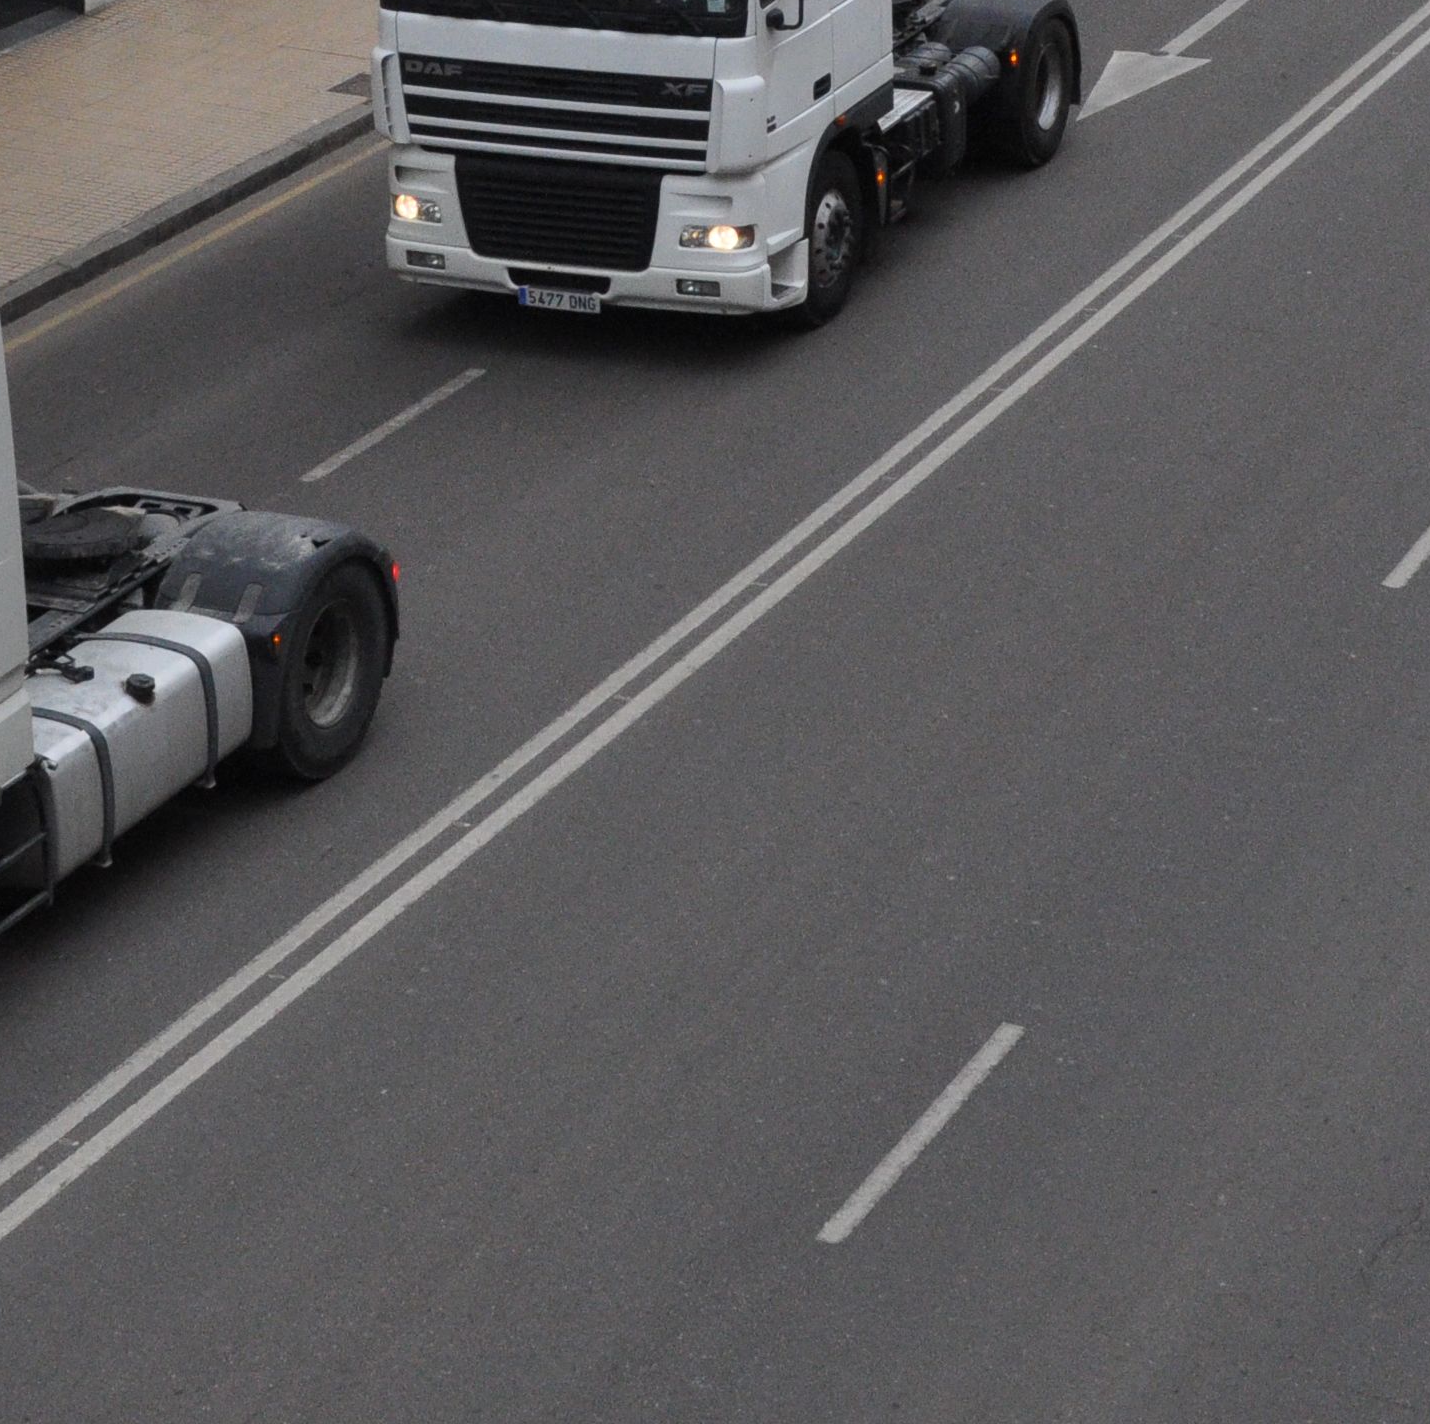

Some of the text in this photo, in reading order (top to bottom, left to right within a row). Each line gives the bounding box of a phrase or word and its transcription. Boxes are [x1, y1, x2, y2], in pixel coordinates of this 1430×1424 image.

[405, 59, 463, 76] DAF
[661, 82, 708, 97] XF
[529, 290, 596, 311] 5477 DNG
